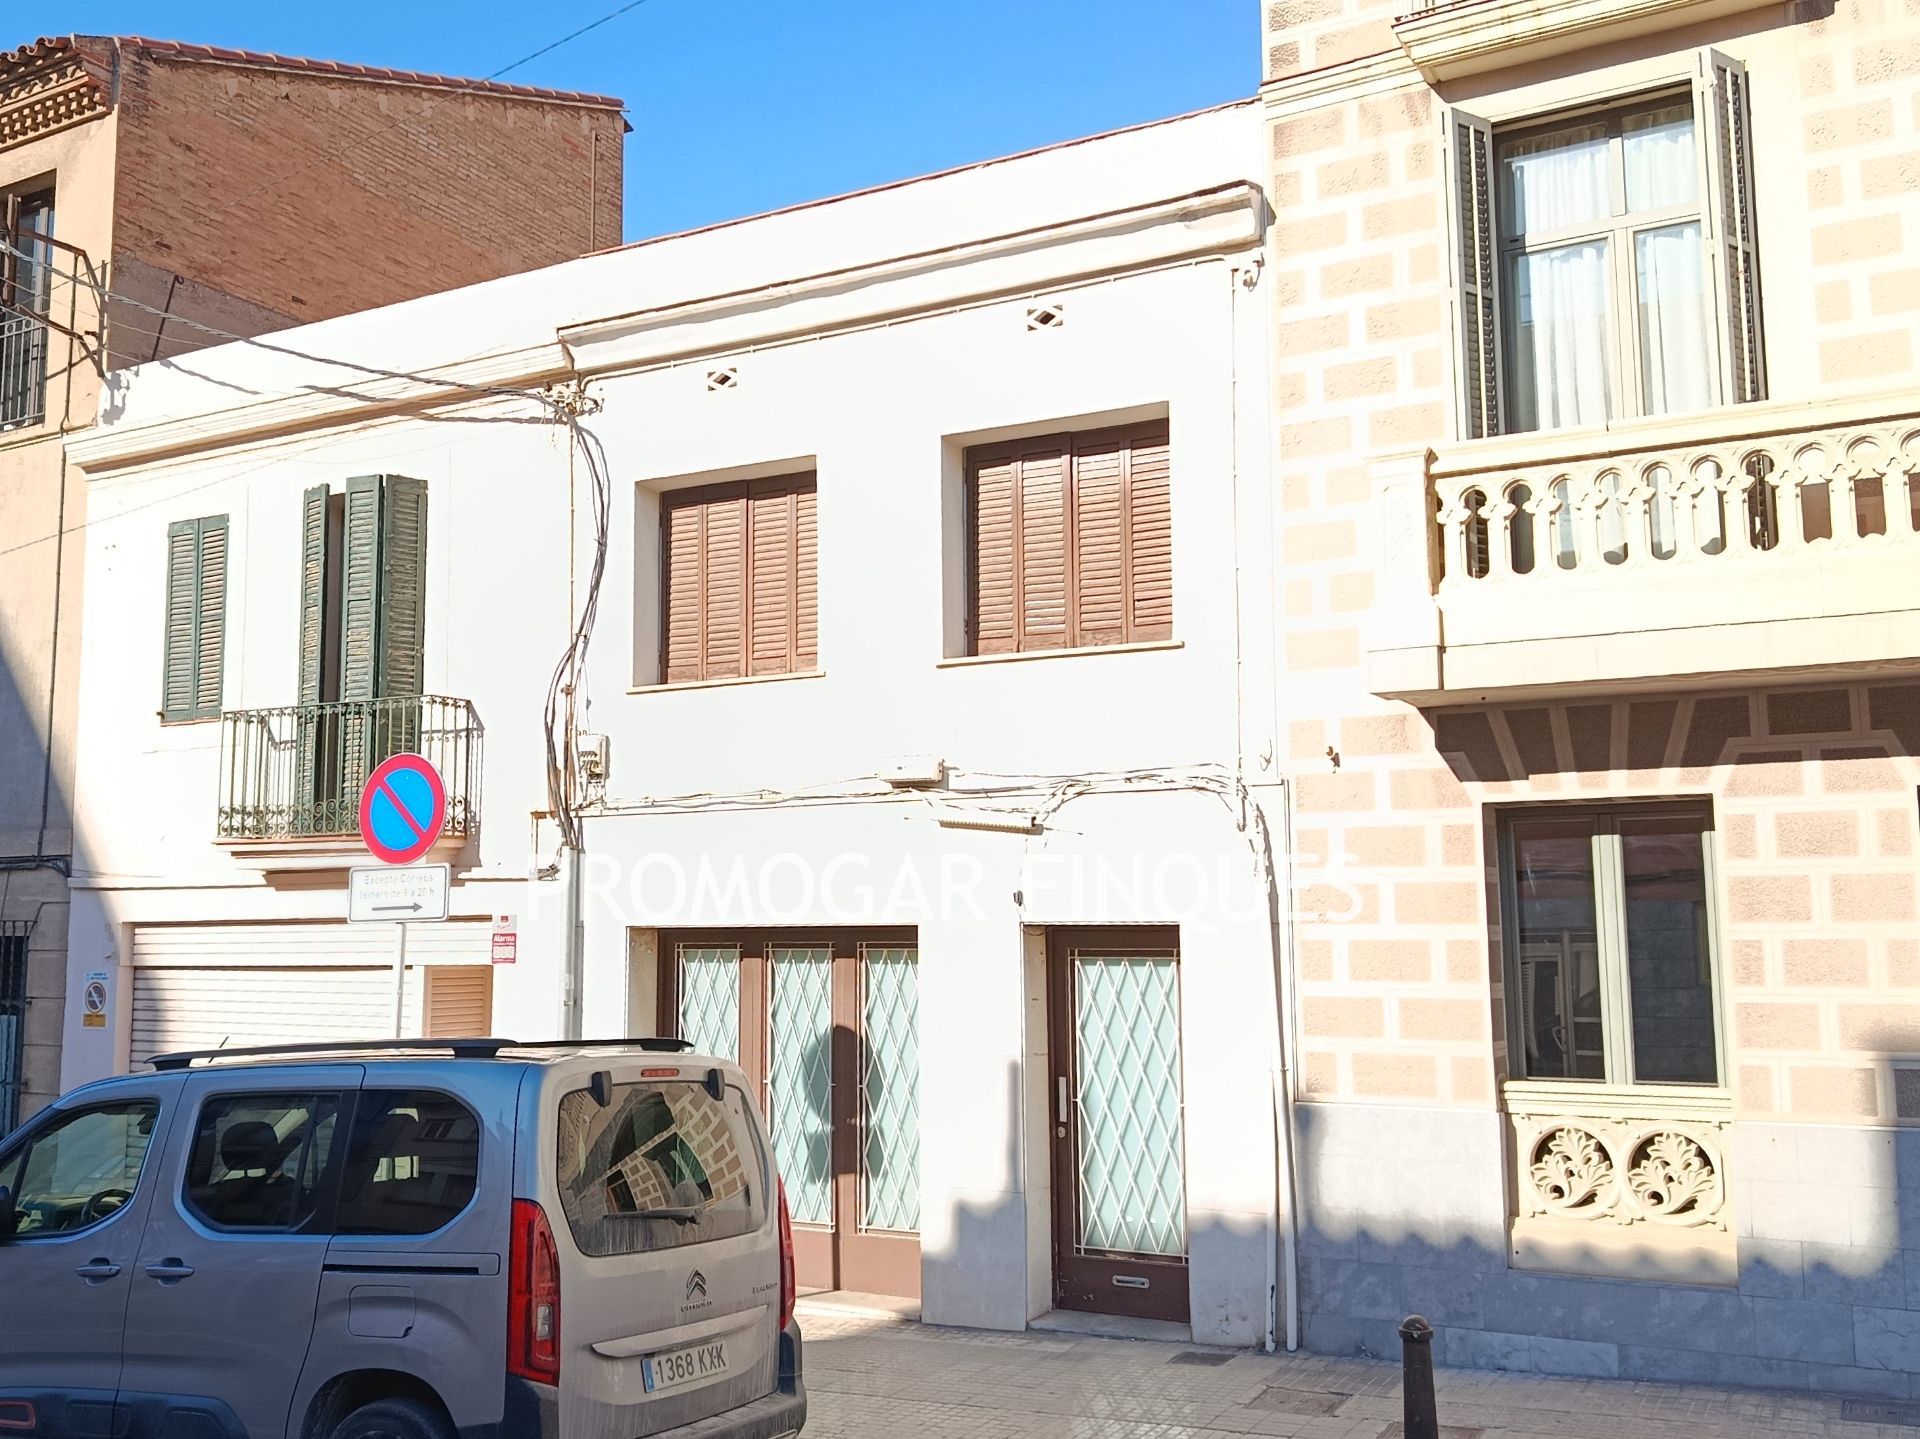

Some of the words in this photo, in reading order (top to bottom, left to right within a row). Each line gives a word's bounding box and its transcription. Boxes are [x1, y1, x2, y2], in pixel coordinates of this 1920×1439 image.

[400, 873, 434, 883] Correos
[657, 1353, 695, 1384] 1368
[698, 1344, 726, 1374] KXK
